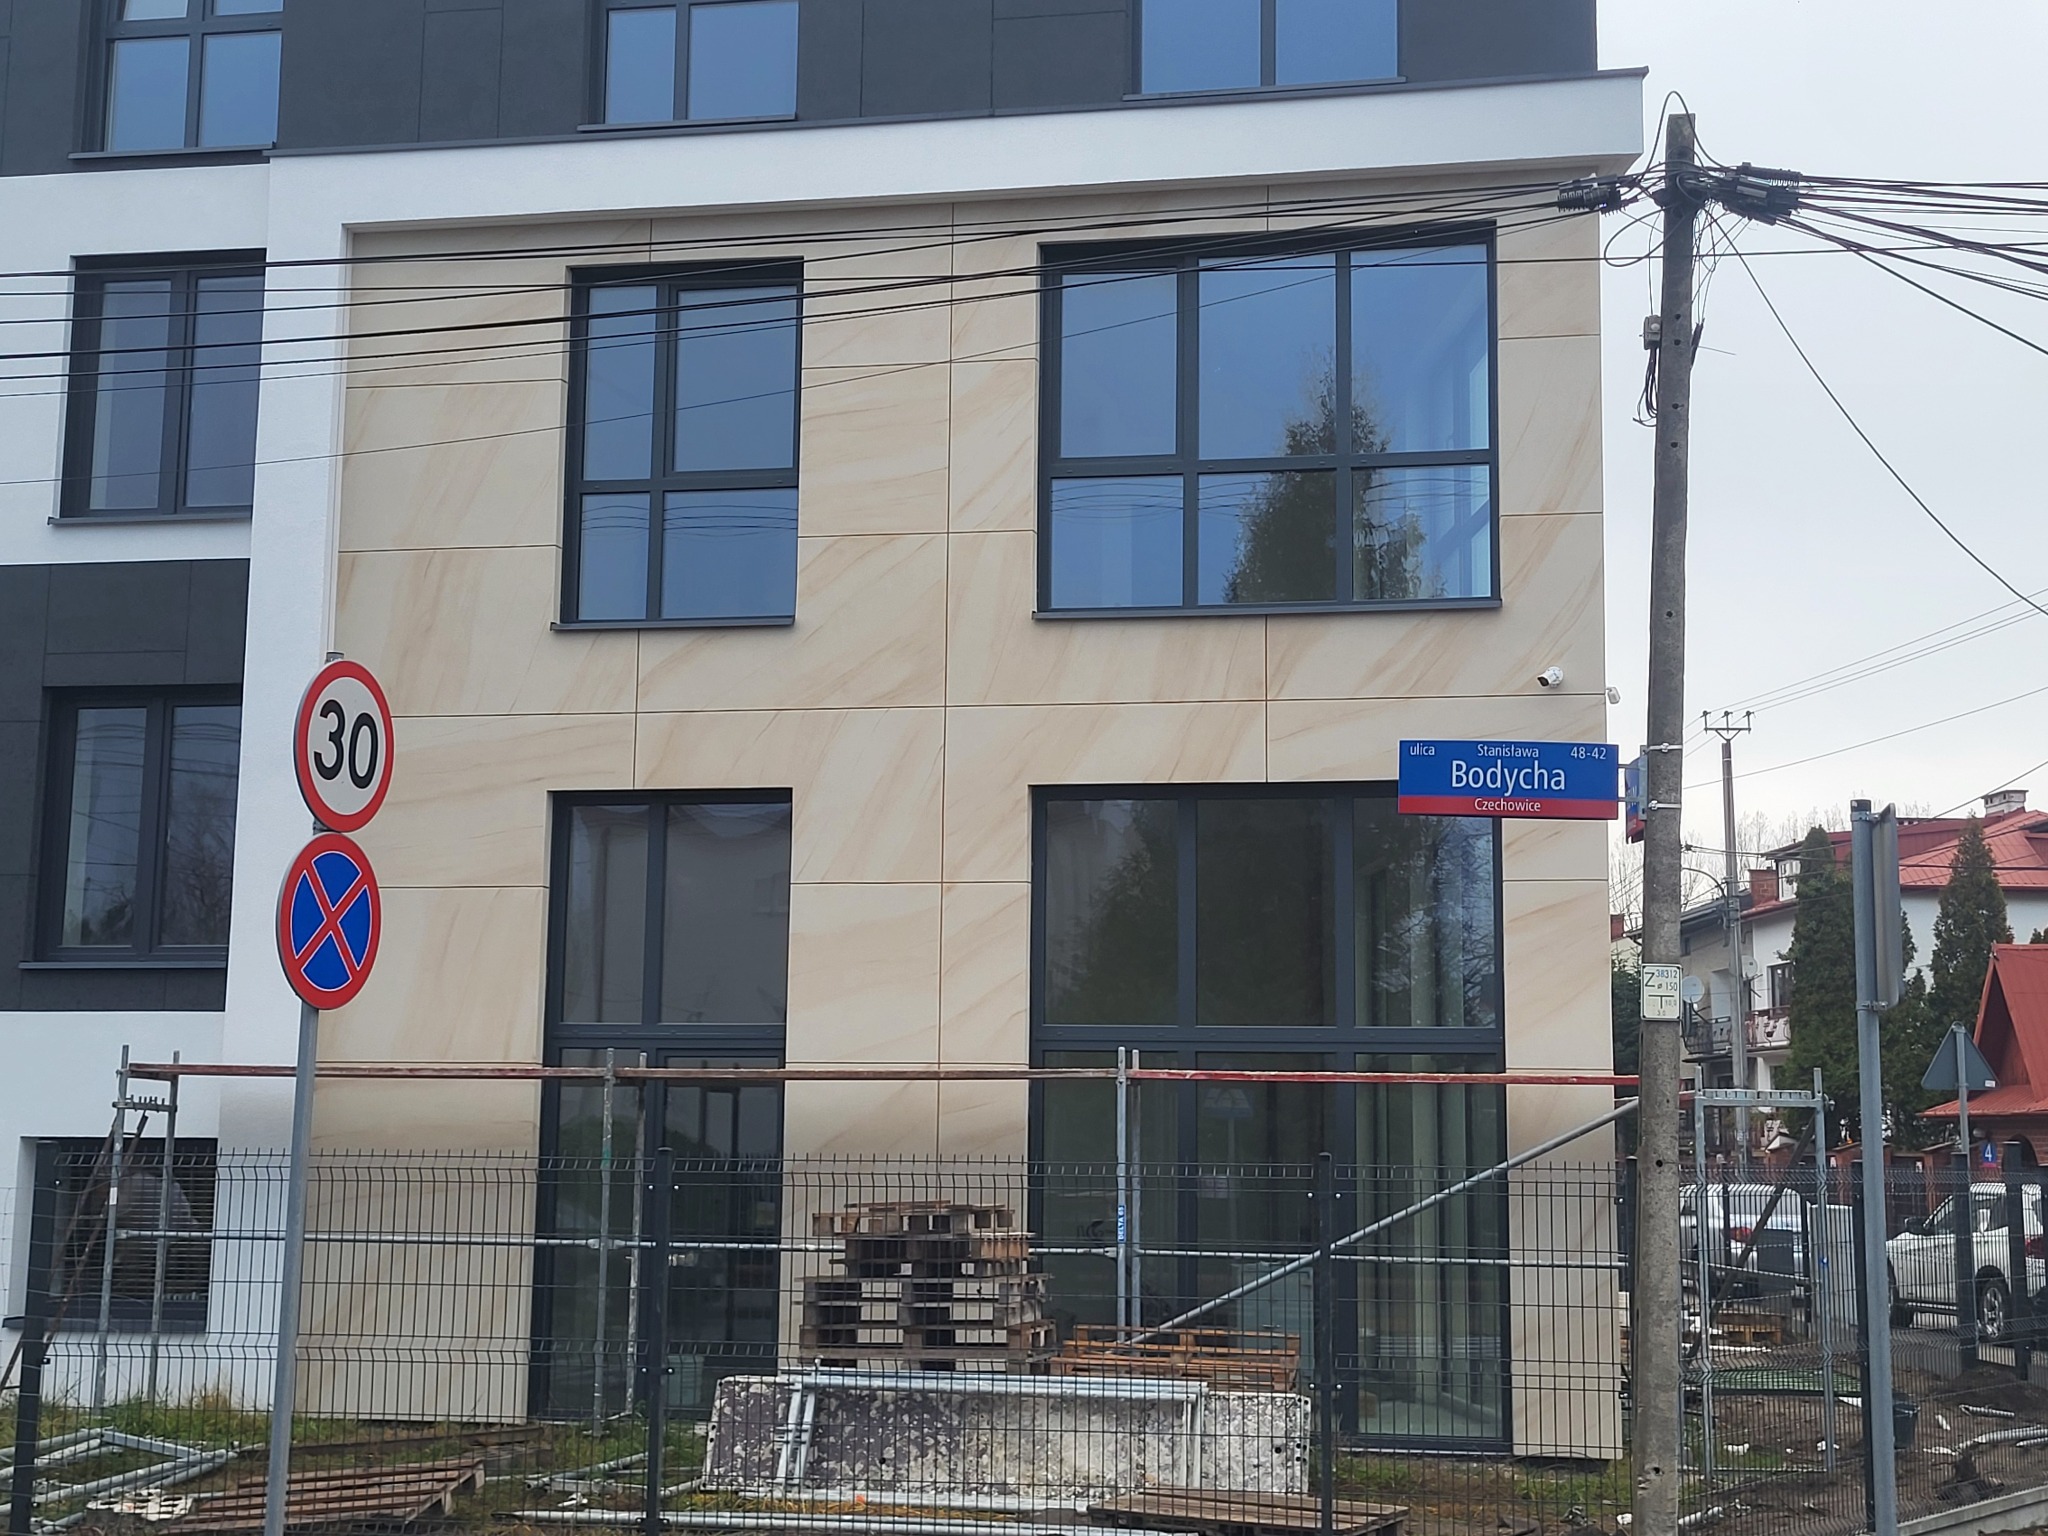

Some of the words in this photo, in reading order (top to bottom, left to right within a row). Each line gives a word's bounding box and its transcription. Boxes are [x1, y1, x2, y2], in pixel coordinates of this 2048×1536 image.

[313, 699, 378, 789] 30
[1410, 743, 1435, 756] ulica
[1477, 744, 1539, 758] Stanisława
[1570, 746, 1607, 760] 48-42
[1452, 759, 1565, 797] Bodycha
[1474, 798, 1541, 812] Czechowice
[1644, 971, 1656, 988] Z
[1665, 981, 1678, 992] 150
[1984, 1143, 1993, 1161] 4
